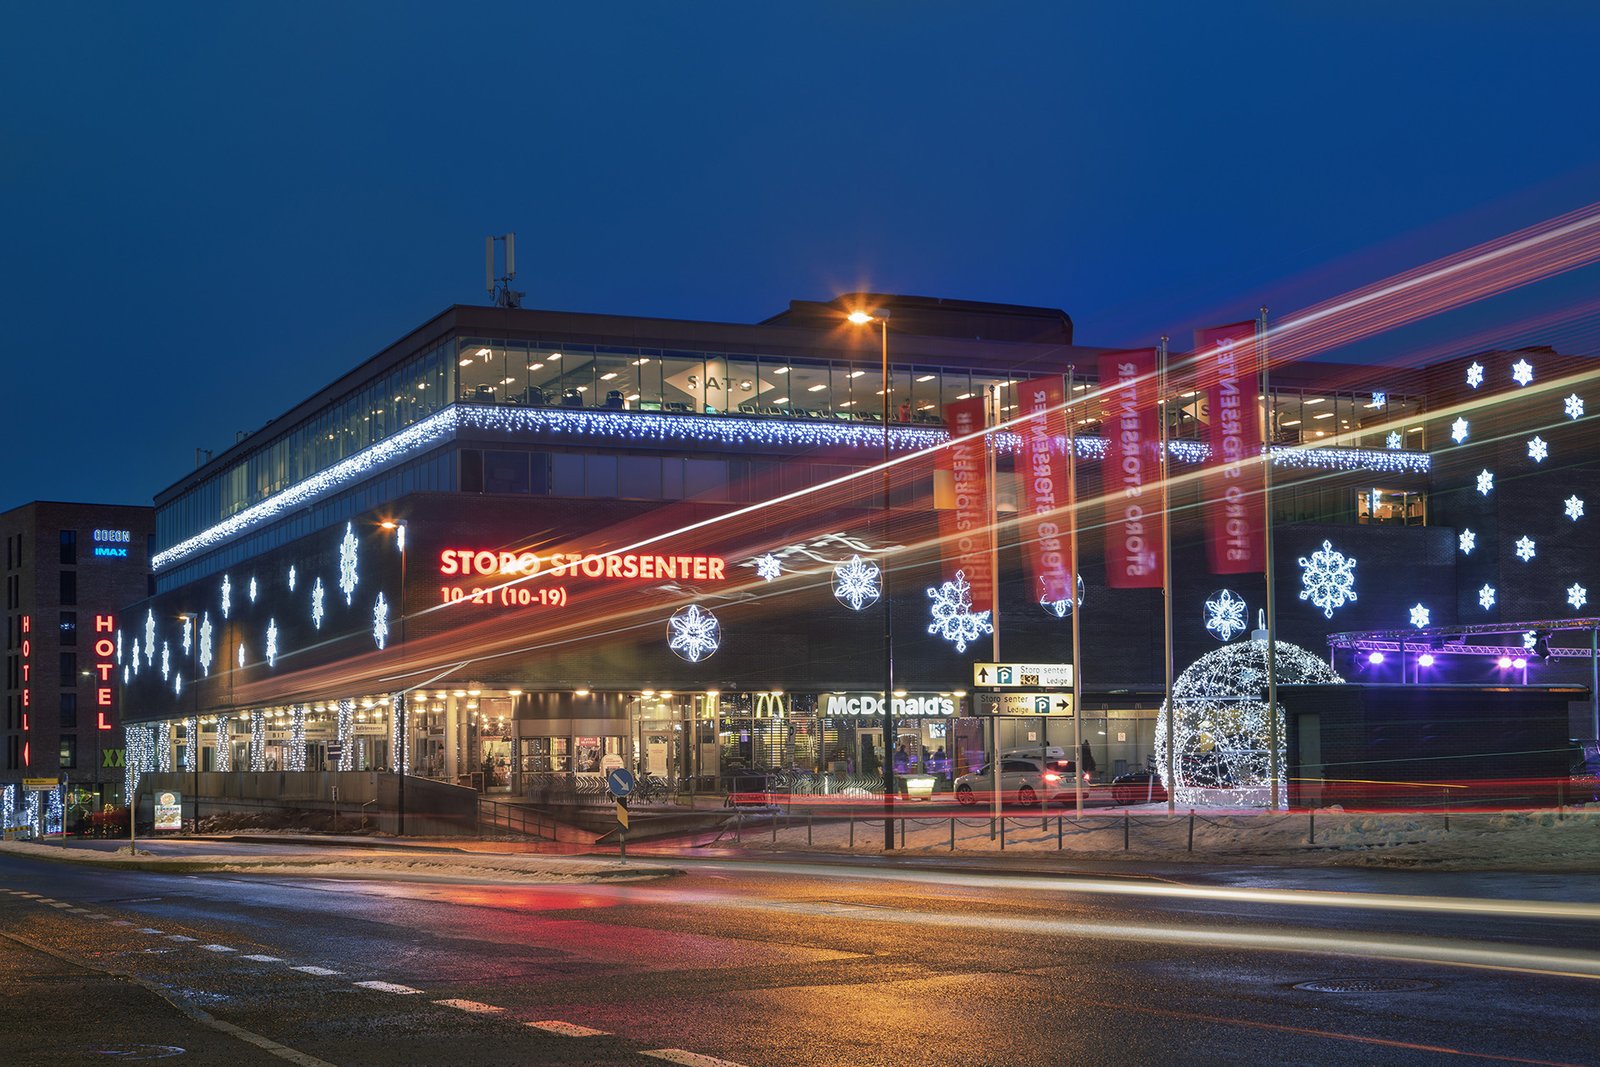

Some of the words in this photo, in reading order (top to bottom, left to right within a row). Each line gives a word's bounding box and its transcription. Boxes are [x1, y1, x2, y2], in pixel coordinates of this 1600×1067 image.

[953, 411, 976, 530] STORSENER
[94, 529, 130, 542] ODEON
[95, 547, 127, 557] IMAX
[549, 552, 726, 580] STORSENTER
[501, 586, 567, 607] (10-19)
[95, 615, 114, 730] HOTEL
[1020, 665, 1040, 674] Storo
[1046, 677, 1068, 685] Ledige
[981, 694, 1000, 703] Storo
[1003, 695, 1028, 703] senter
[1007, 706, 1029, 714] Ledige
